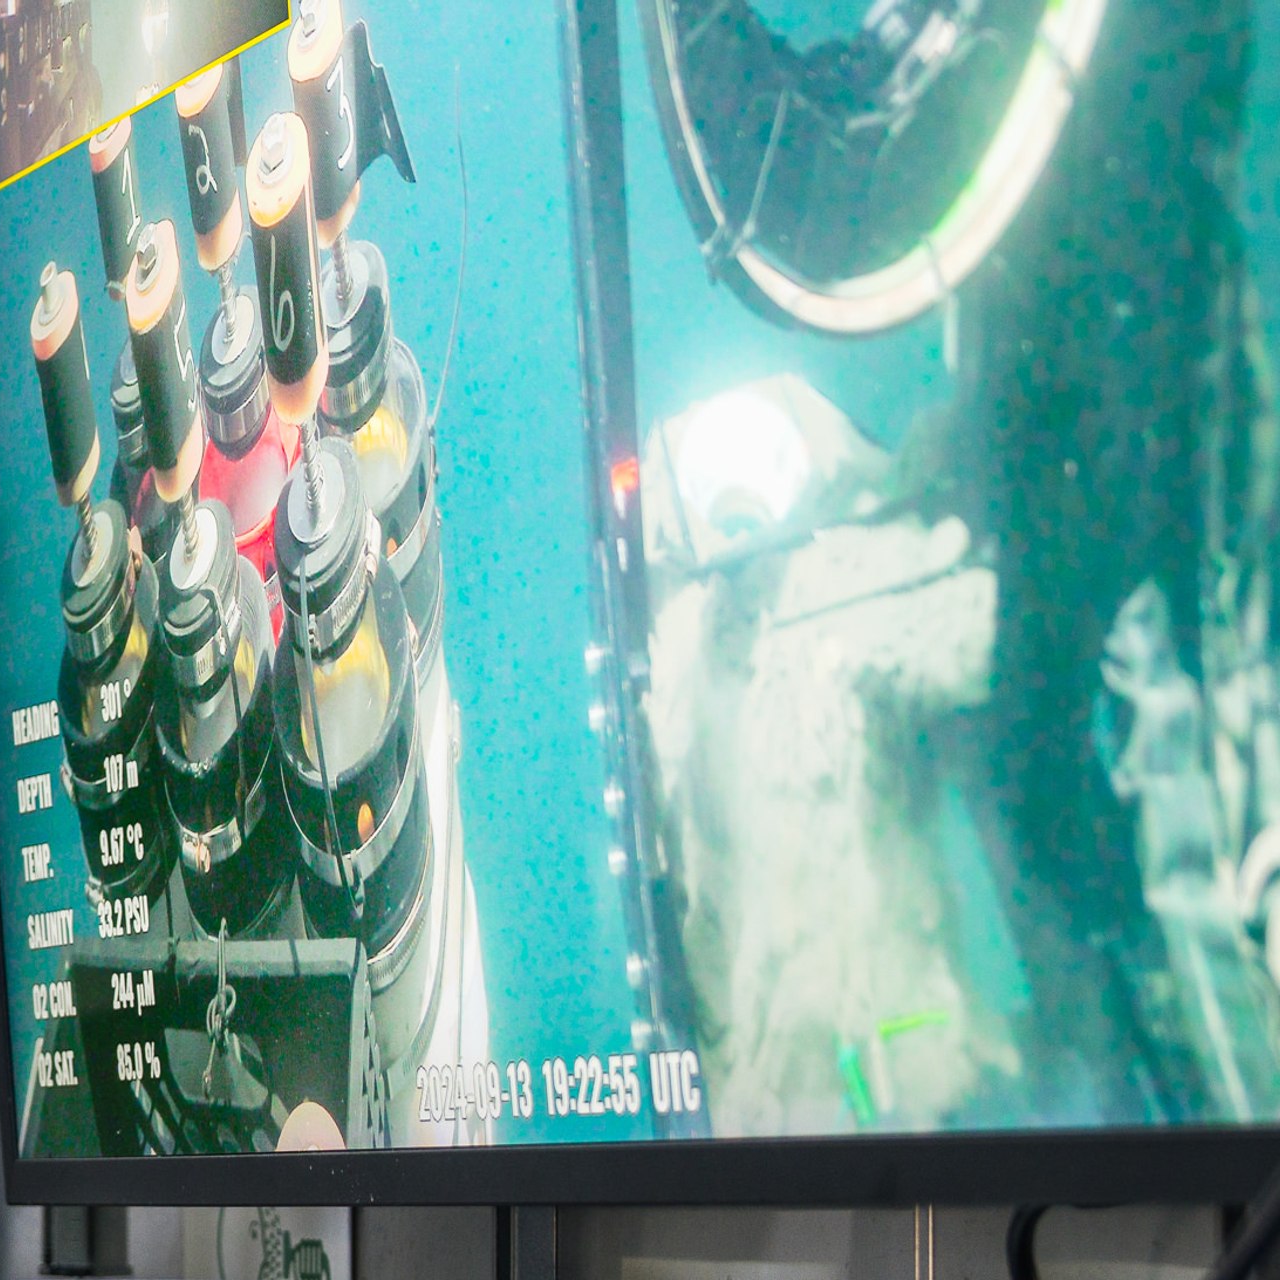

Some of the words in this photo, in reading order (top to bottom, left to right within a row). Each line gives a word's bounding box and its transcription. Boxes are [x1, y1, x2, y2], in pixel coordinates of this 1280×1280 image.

[326, 55, 355, 170] 3
[188, 124, 218, 194] 2
[269, 235, 295, 352] 6
[173, 298, 197, 411] 5
[11, 699, 61, 746] HEADING
[100, 681, 123, 723] 301
[16, 773, 53, 815] DEPTH
[103, 753, 124, 794] 107
[125, 760, 139, 789] m
[21, 842, 55, 883] TEMP.
[99, 826, 125, 867] 9.67
[125, 822, 145, 861] °C
[26, 908, 75, 949] SALINITY
[96, 898, 124, 939] 33.2
[123, 894, 150, 935] PSU
[48, 980, 77, 1018] CON.
[111, 971, 135, 1010] 244
[53, 1050, 79, 1086] SAT.
[116, 1041, 144, 1081] 85.0
[144, 1041, 161, 1079] %
[416, 1058, 533, 1123] 2024-09-13
[541, 1053, 640, 1118] 19:22:55
[649, 1048, 701, 1114] UTC
